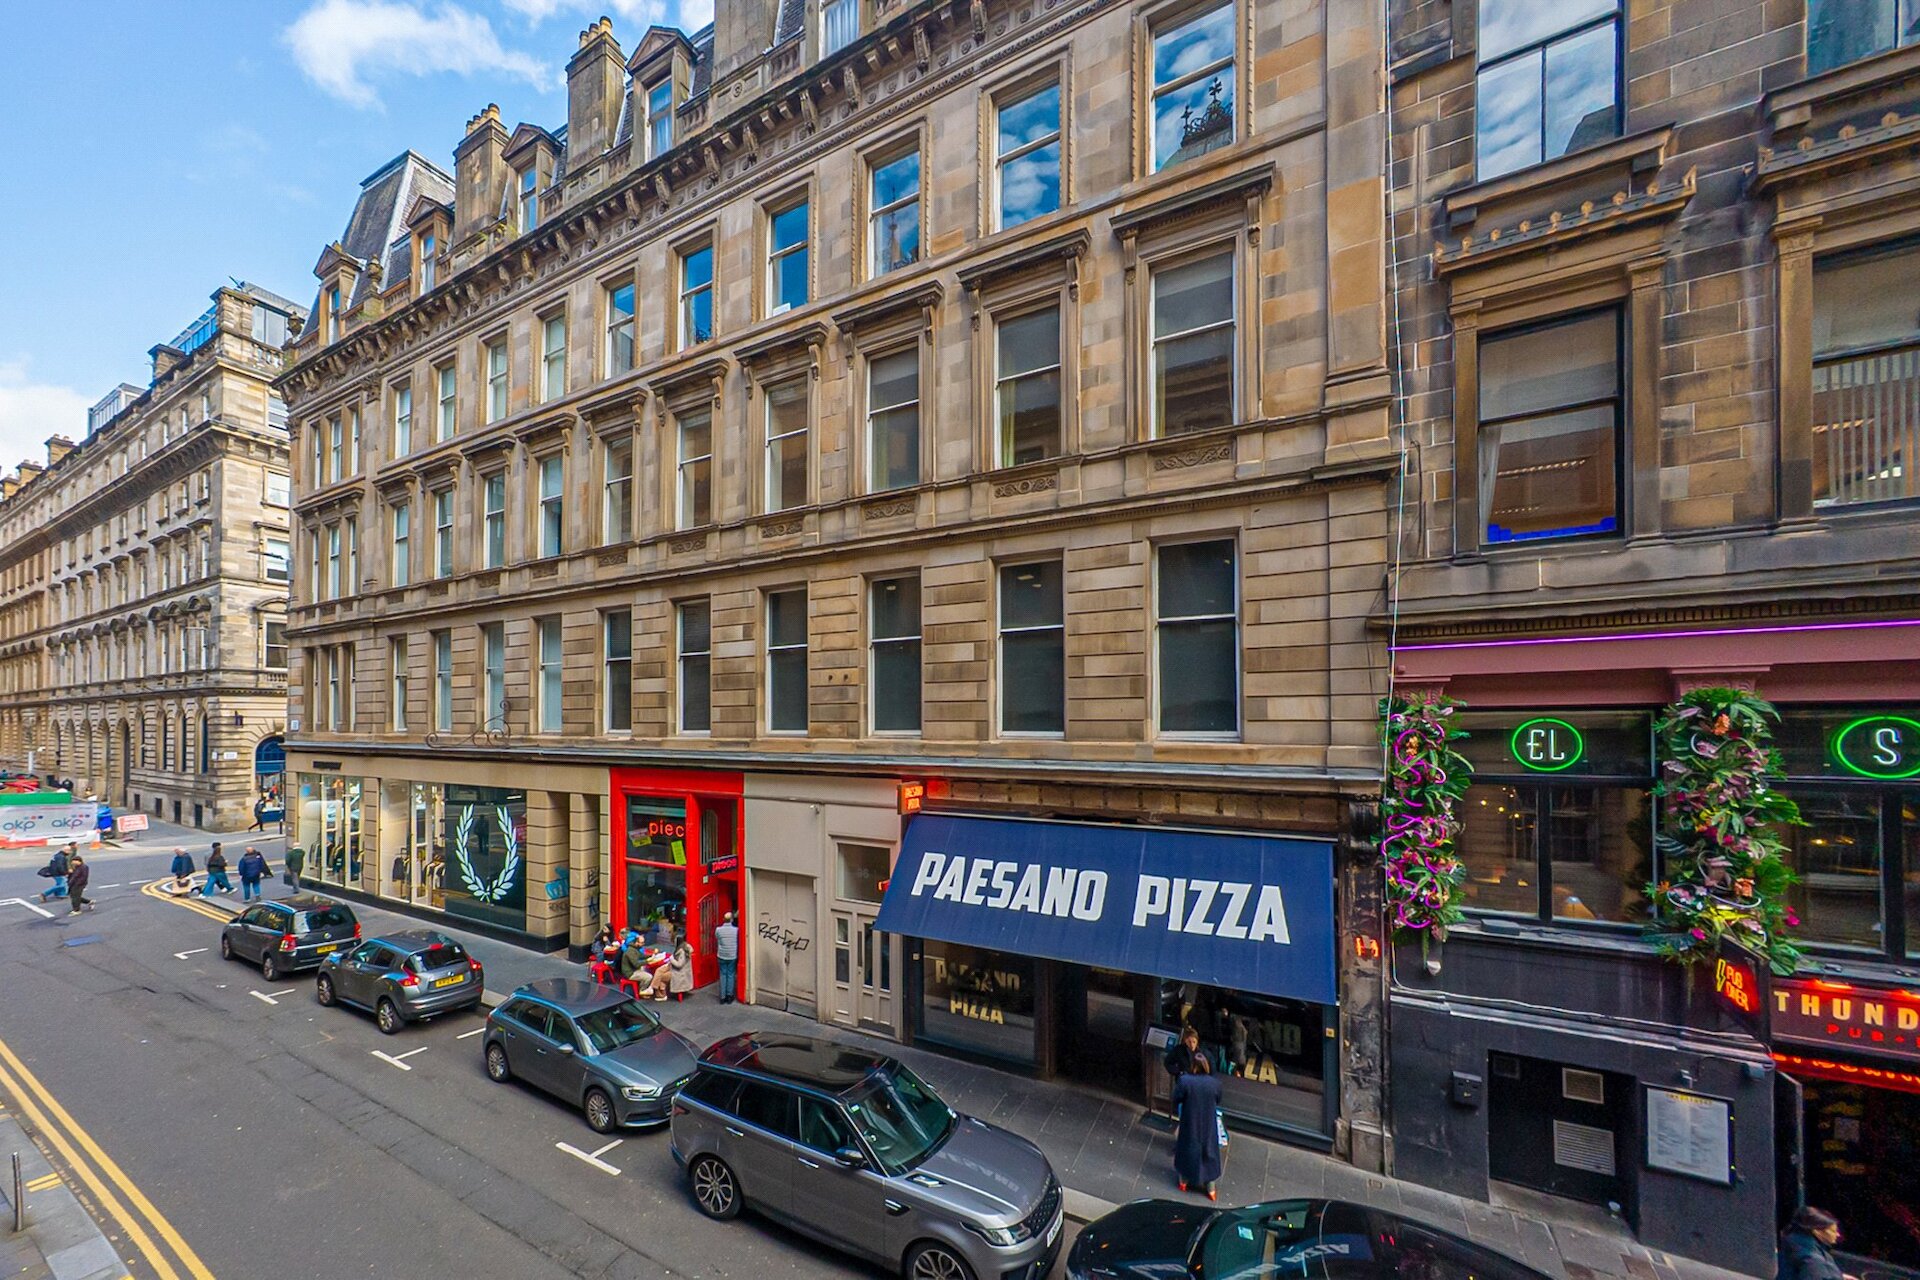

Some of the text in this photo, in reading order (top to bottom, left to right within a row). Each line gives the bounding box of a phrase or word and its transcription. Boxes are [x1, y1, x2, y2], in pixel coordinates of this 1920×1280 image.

[1526, 729, 1565, 760] EL
[1873, 728, 1900, 765] S
[910, 852, 1291, 945] PAESANO PIZZA
[935, 959, 1020, 991] PAEANO
[1726, 965, 1743, 989] PUB
[950, 993, 1004, 1025] PIZZA
[1773, 990, 1920, 1031] THUND
